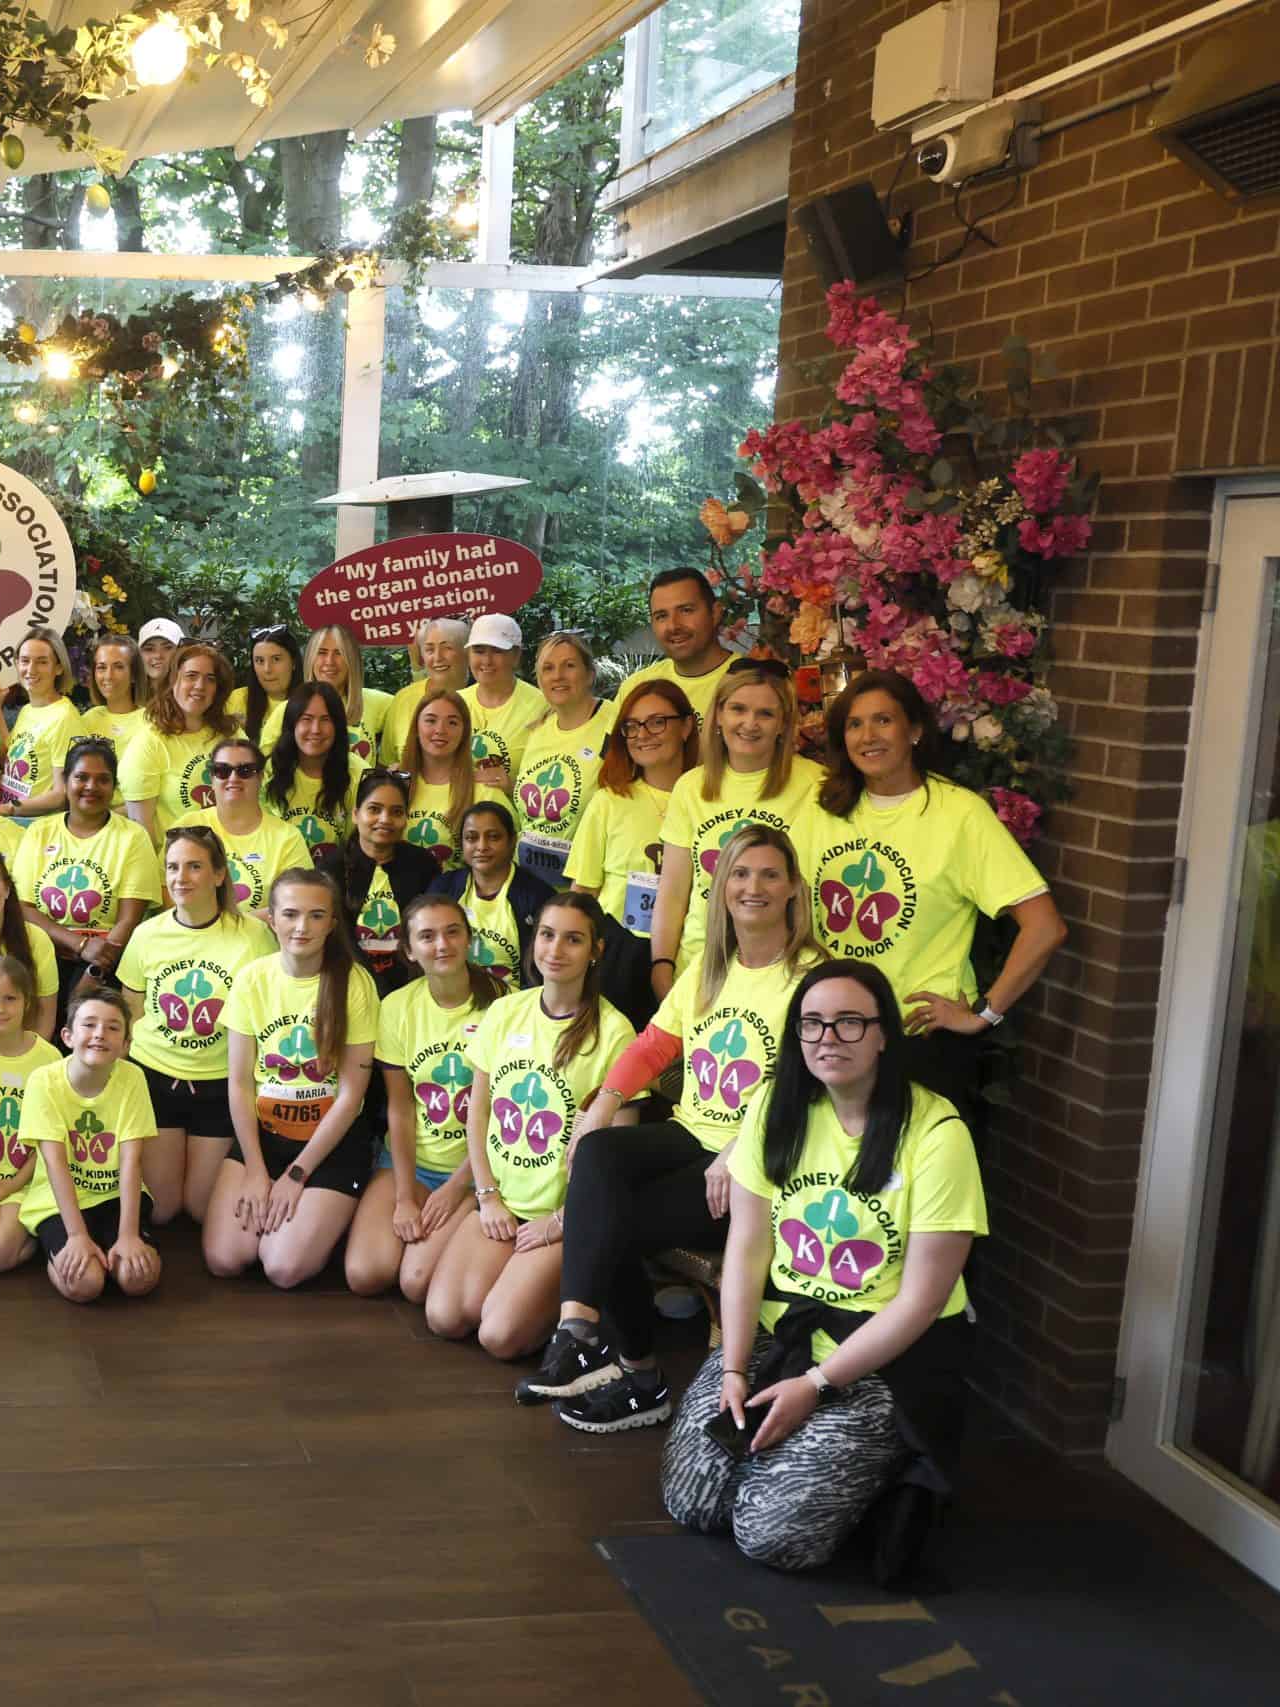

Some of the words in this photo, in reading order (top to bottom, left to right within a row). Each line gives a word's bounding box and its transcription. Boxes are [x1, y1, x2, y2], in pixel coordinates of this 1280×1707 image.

[382, 549, 451, 574] family
[455, 539, 497, 562] had
[314, 587, 351, 607] the
[356, 577, 417, 599] organ
[422, 561, 520, 589] donation
[350, 586, 496, 622] conversation,
[364, 620, 401, 640] has
[182, 753, 208, 780] KIDNEY
[180, 781, 193, 808] IRISH
[697, 808, 745, 838] KIDNEY
[821, 838, 868, 865] KIDNEY
[870, 841, 917, 930] ASSOCIATION
[844, 937, 895, 958] DONOR
[258, 1014, 299, 1042] KIDNEY
[693, 1007, 740, 1036] KIDNEY
[180, 1031, 223, 1049] DONOR
[409, 1041, 449, 1072] KIDNEY
[296, 1087, 327, 1099] MARIA
[536, 1064, 577, 1146] ASSOCIATION
[273, 1103, 320, 1122] 47765
[490, 1134, 503, 1152] BE
[502, 1151, 510, 1162] A
[513, 1151, 556, 1168] DONOR
[73, 1177, 119, 1192] OCIATIO
[86, 1168, 120, 1179] KIDNE
[780, 1172, 840, 1202] KIDNEY
[778, 1263, 801, 1282] BE
